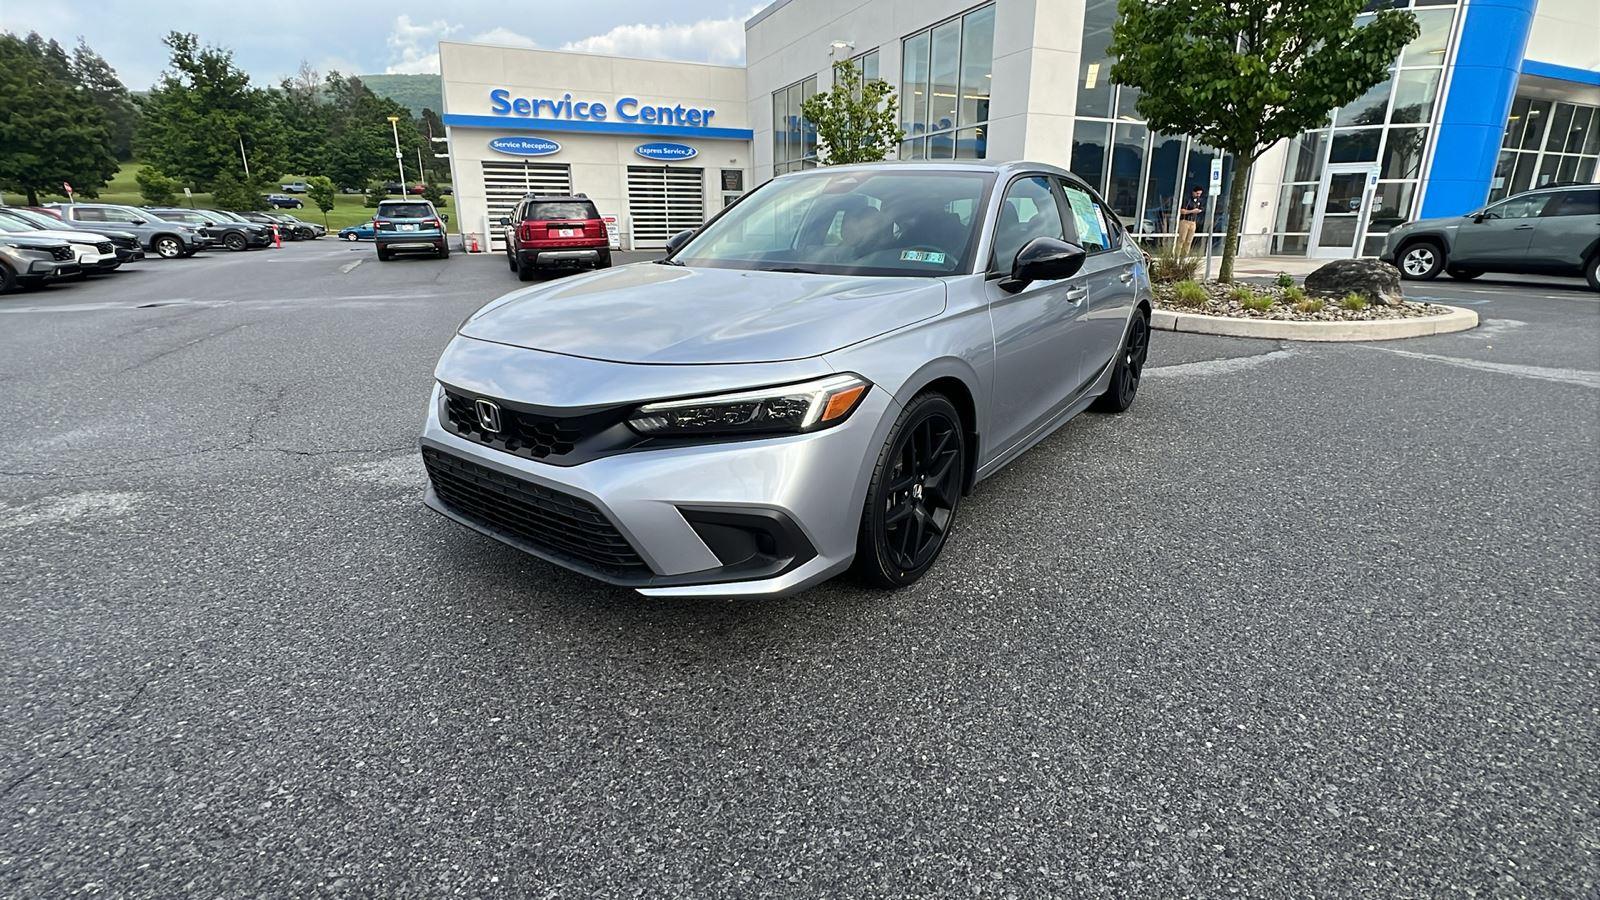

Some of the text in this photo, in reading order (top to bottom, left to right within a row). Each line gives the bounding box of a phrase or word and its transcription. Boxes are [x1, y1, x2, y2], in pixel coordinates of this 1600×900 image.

[490, 88, 716, 127] Service Center
[493, 140, 557, 151] Service Reception
[639, 146, 686, 156] Express Service
